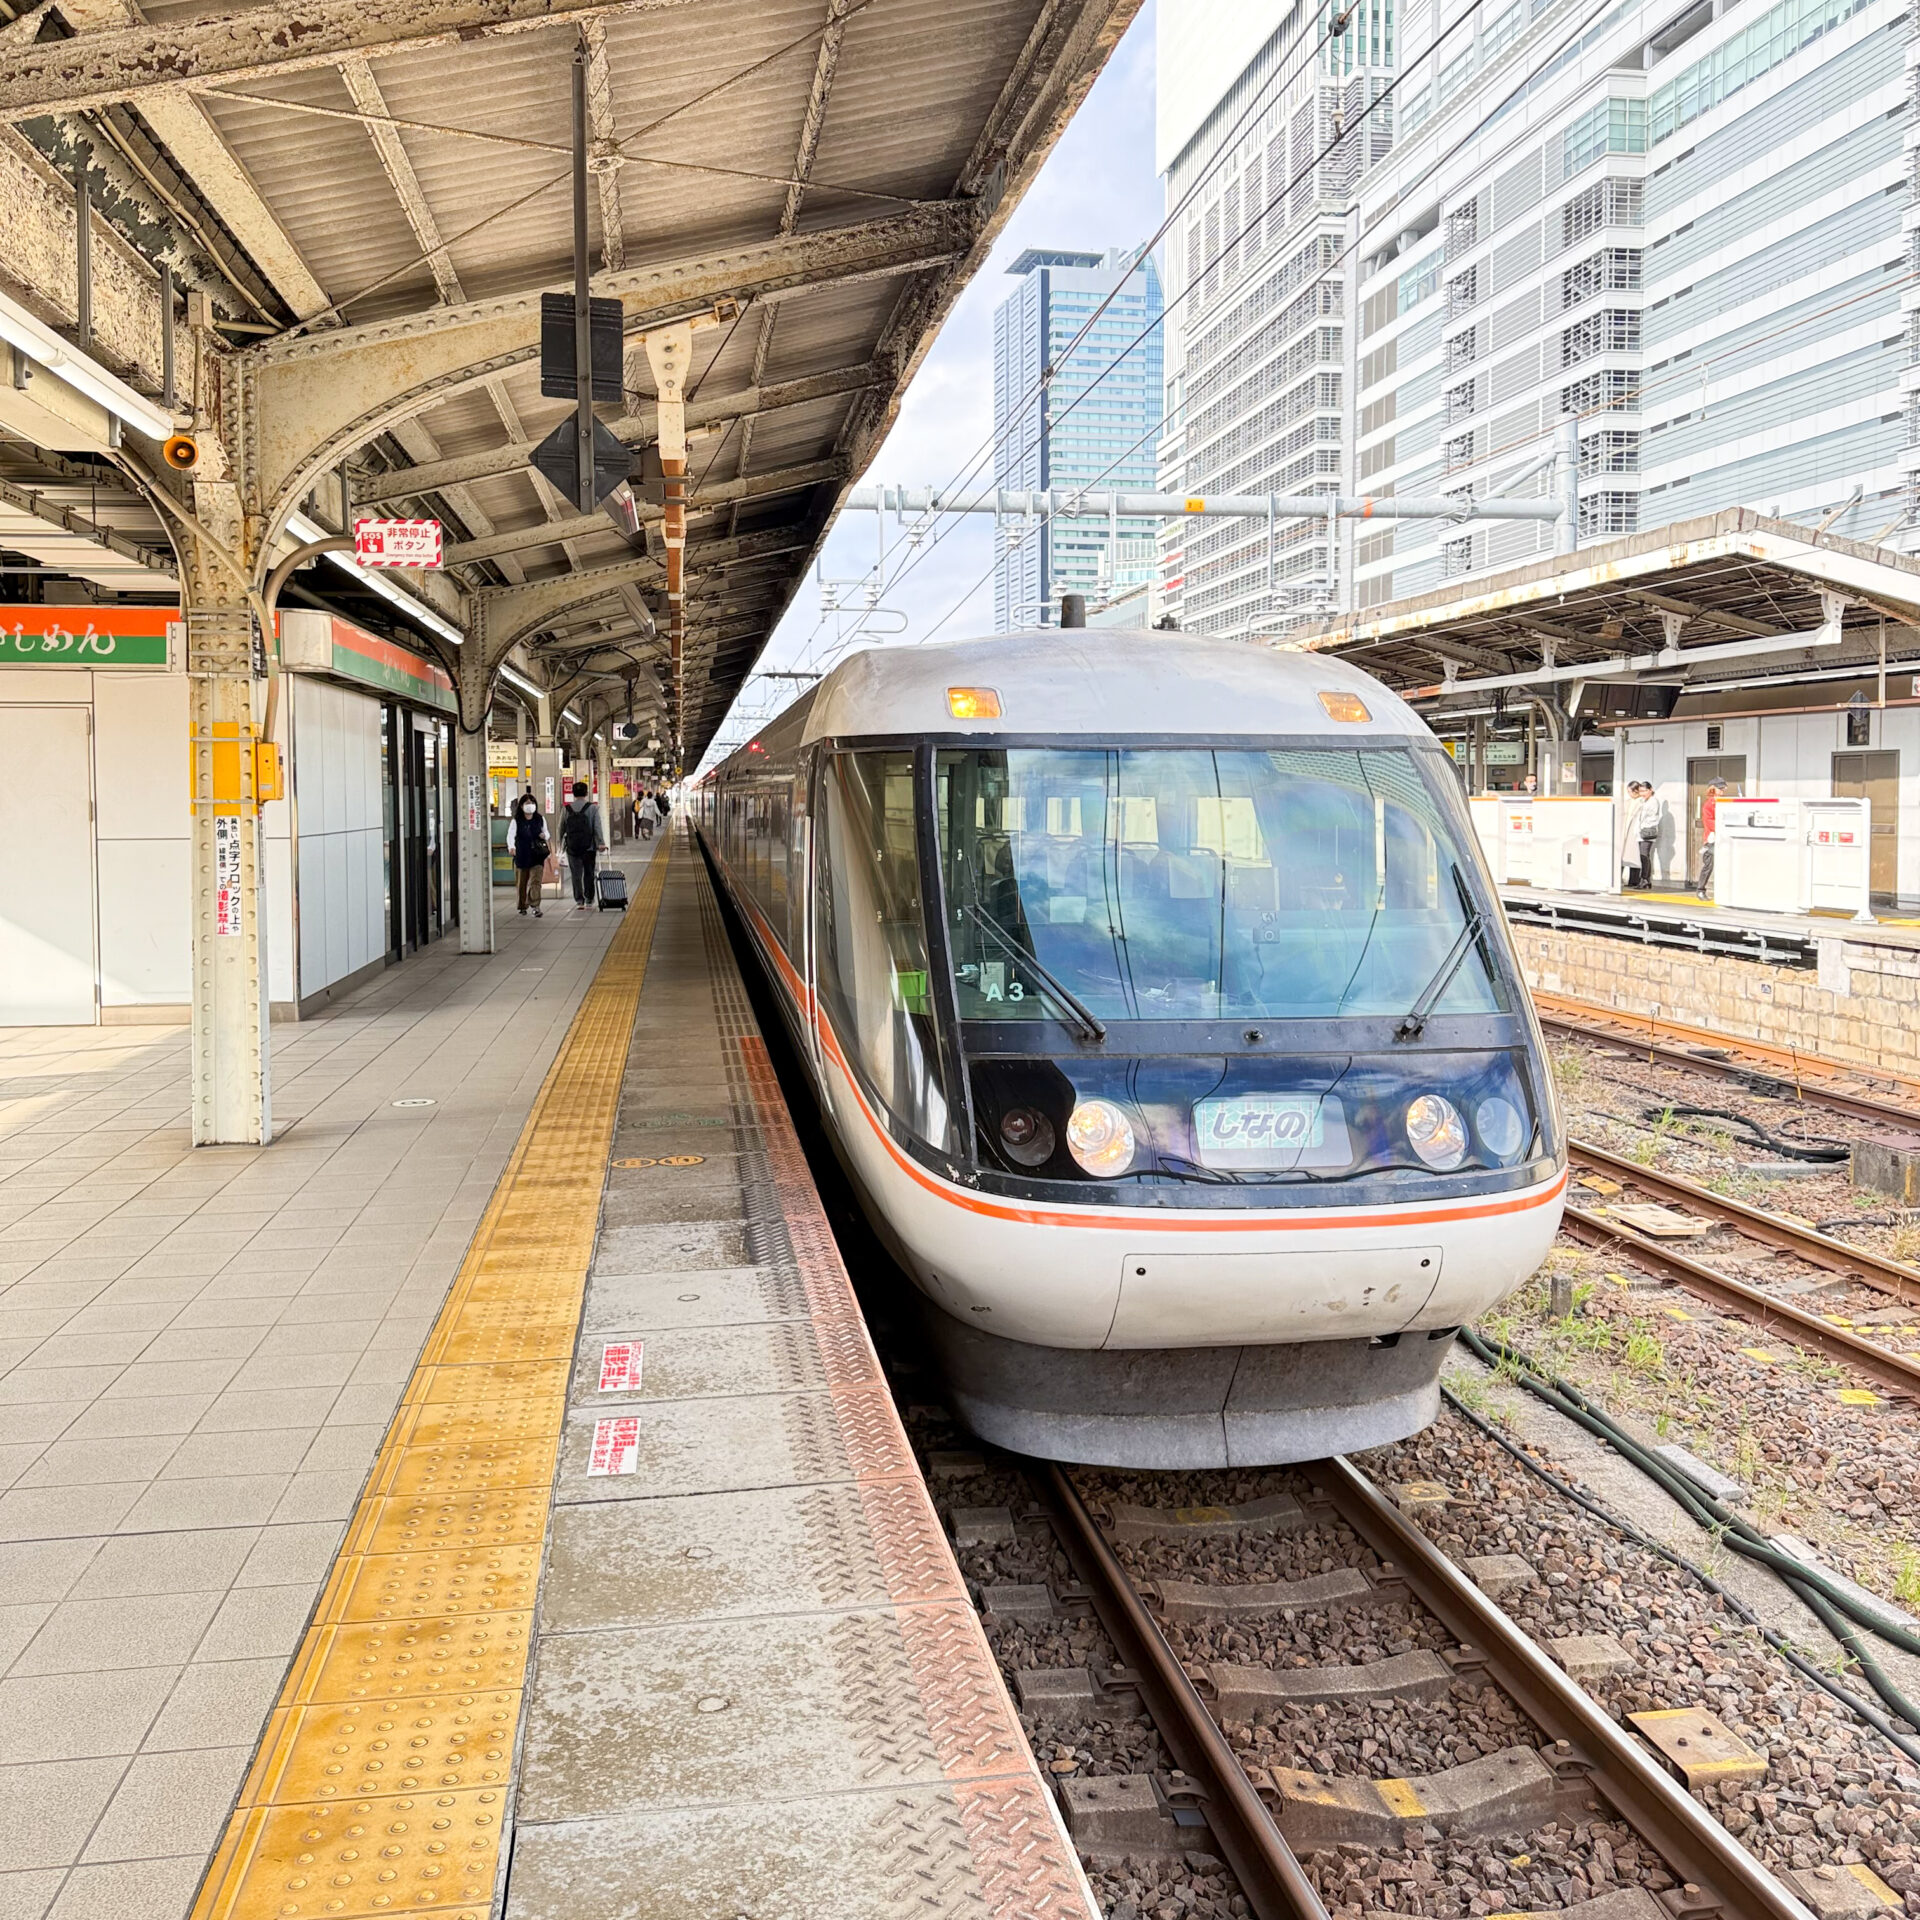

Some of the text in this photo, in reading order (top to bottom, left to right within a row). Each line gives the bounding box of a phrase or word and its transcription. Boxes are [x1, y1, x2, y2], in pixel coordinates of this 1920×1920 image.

[387, 527, 431, 539] 非常停止
[393, 540, 426, 551] ボタン
[0, 622, 116, 655] しめん
[1212, 1111, 1306, 1139] しなの
[600, 1344, 630, 1390] 撮影禁止
